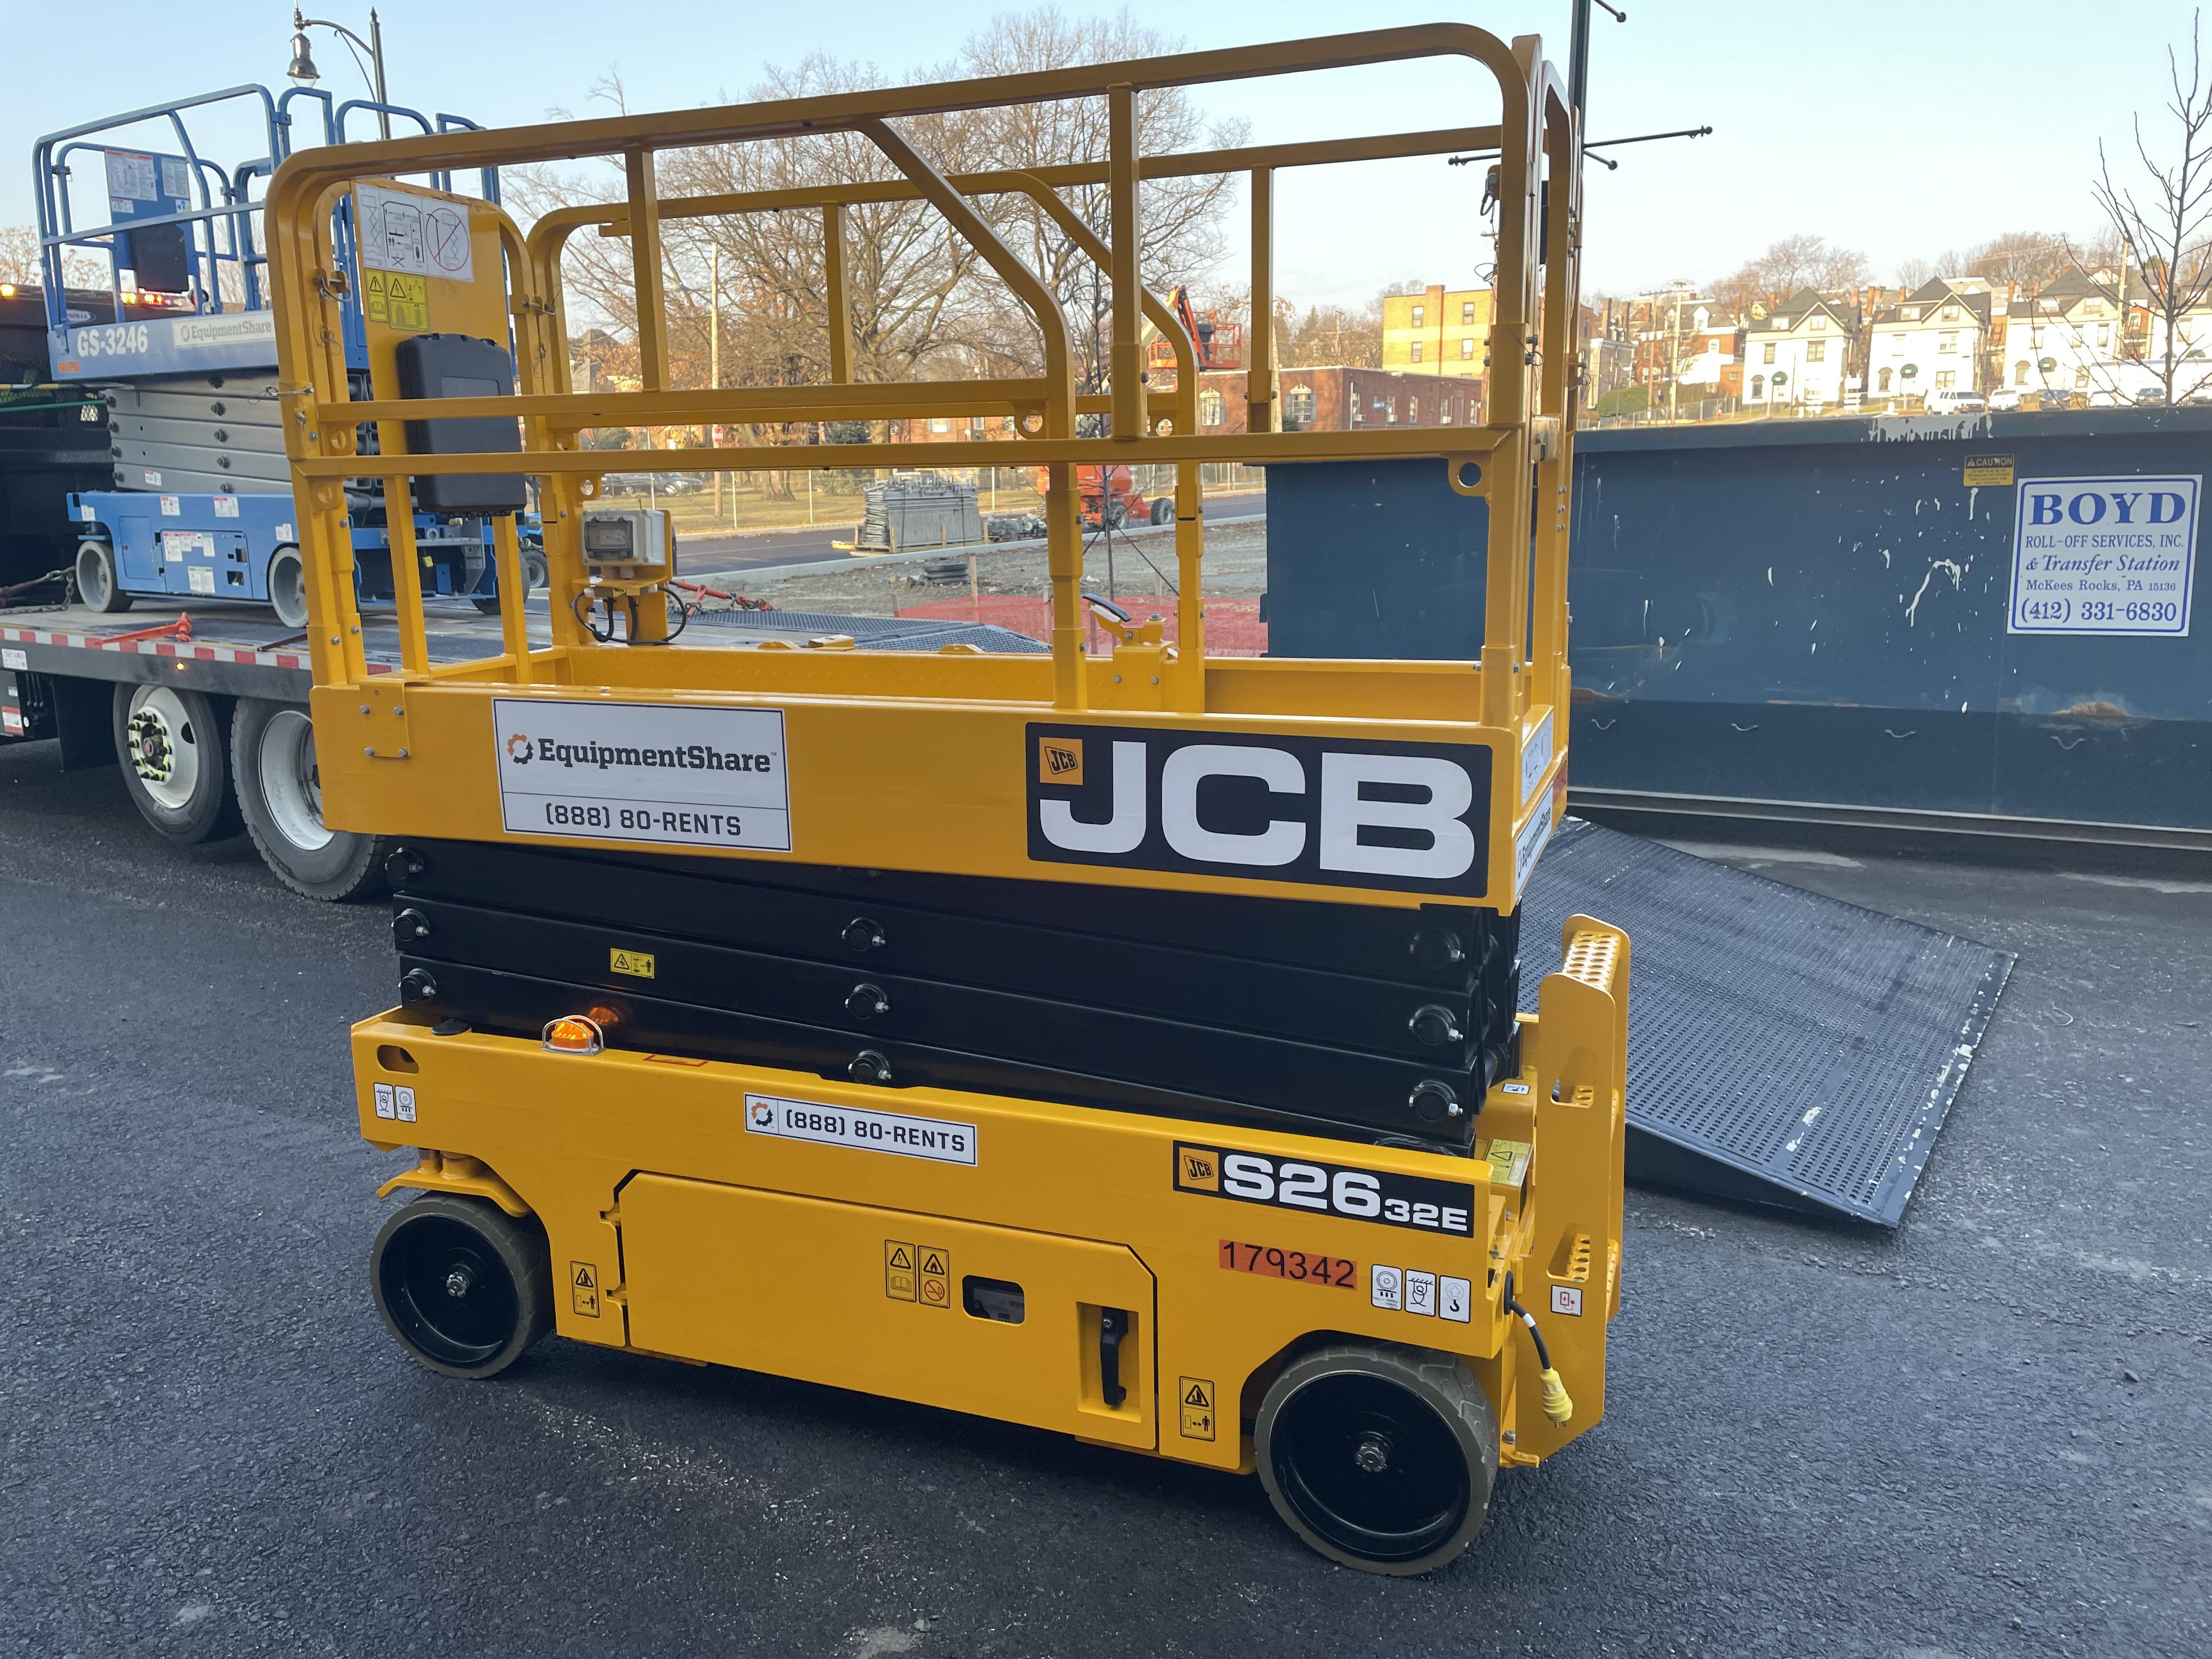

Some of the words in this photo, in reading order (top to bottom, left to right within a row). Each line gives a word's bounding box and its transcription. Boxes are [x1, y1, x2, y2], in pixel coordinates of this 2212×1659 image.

[77, 325, 148, 357] GS-3246
[192, 321, 272, 341] EquipmentShare
[1976, 456, 2012, 467] CAUTION
[2029, 493, 2186, 525] BOYD
[2025, 535, 2088, 549] ROLL-OFF
[2092, 534, 2155, 549] SERVICES,
[2159, 534, 2184, 548] INC.
[2026, 558, 2039, 571] &
[2042, 554, 2112, 575] Transfer
[2117, 554, 2180, 572] Station
[2026, 579, 2073, 591] McKees
[2079, 579, 2120, 592] Rocks,
[2126, 580, 2143, 591] PA
[2148, 582, 2176, 591] 15136
[2021, 598, 2071, 623] (412)
[2081, 601, 2176, 622] 331-6830
[538, 738, 771, 772] EquipmentShare
[1051, 749, 1076, 771] JCB
[546, 803, 610, 828] (888)
[619, 809, 741, 836] 80-RENTS
[1040, 740, 1475, 879] JCB
[786, 1109, 845, 1136] (888)
[855, 1120, 965, 1152] 80-RENTS
[1188, 1159, 1212, 1178] JCB
[1223, 1241, 1354, 1288] 179342
